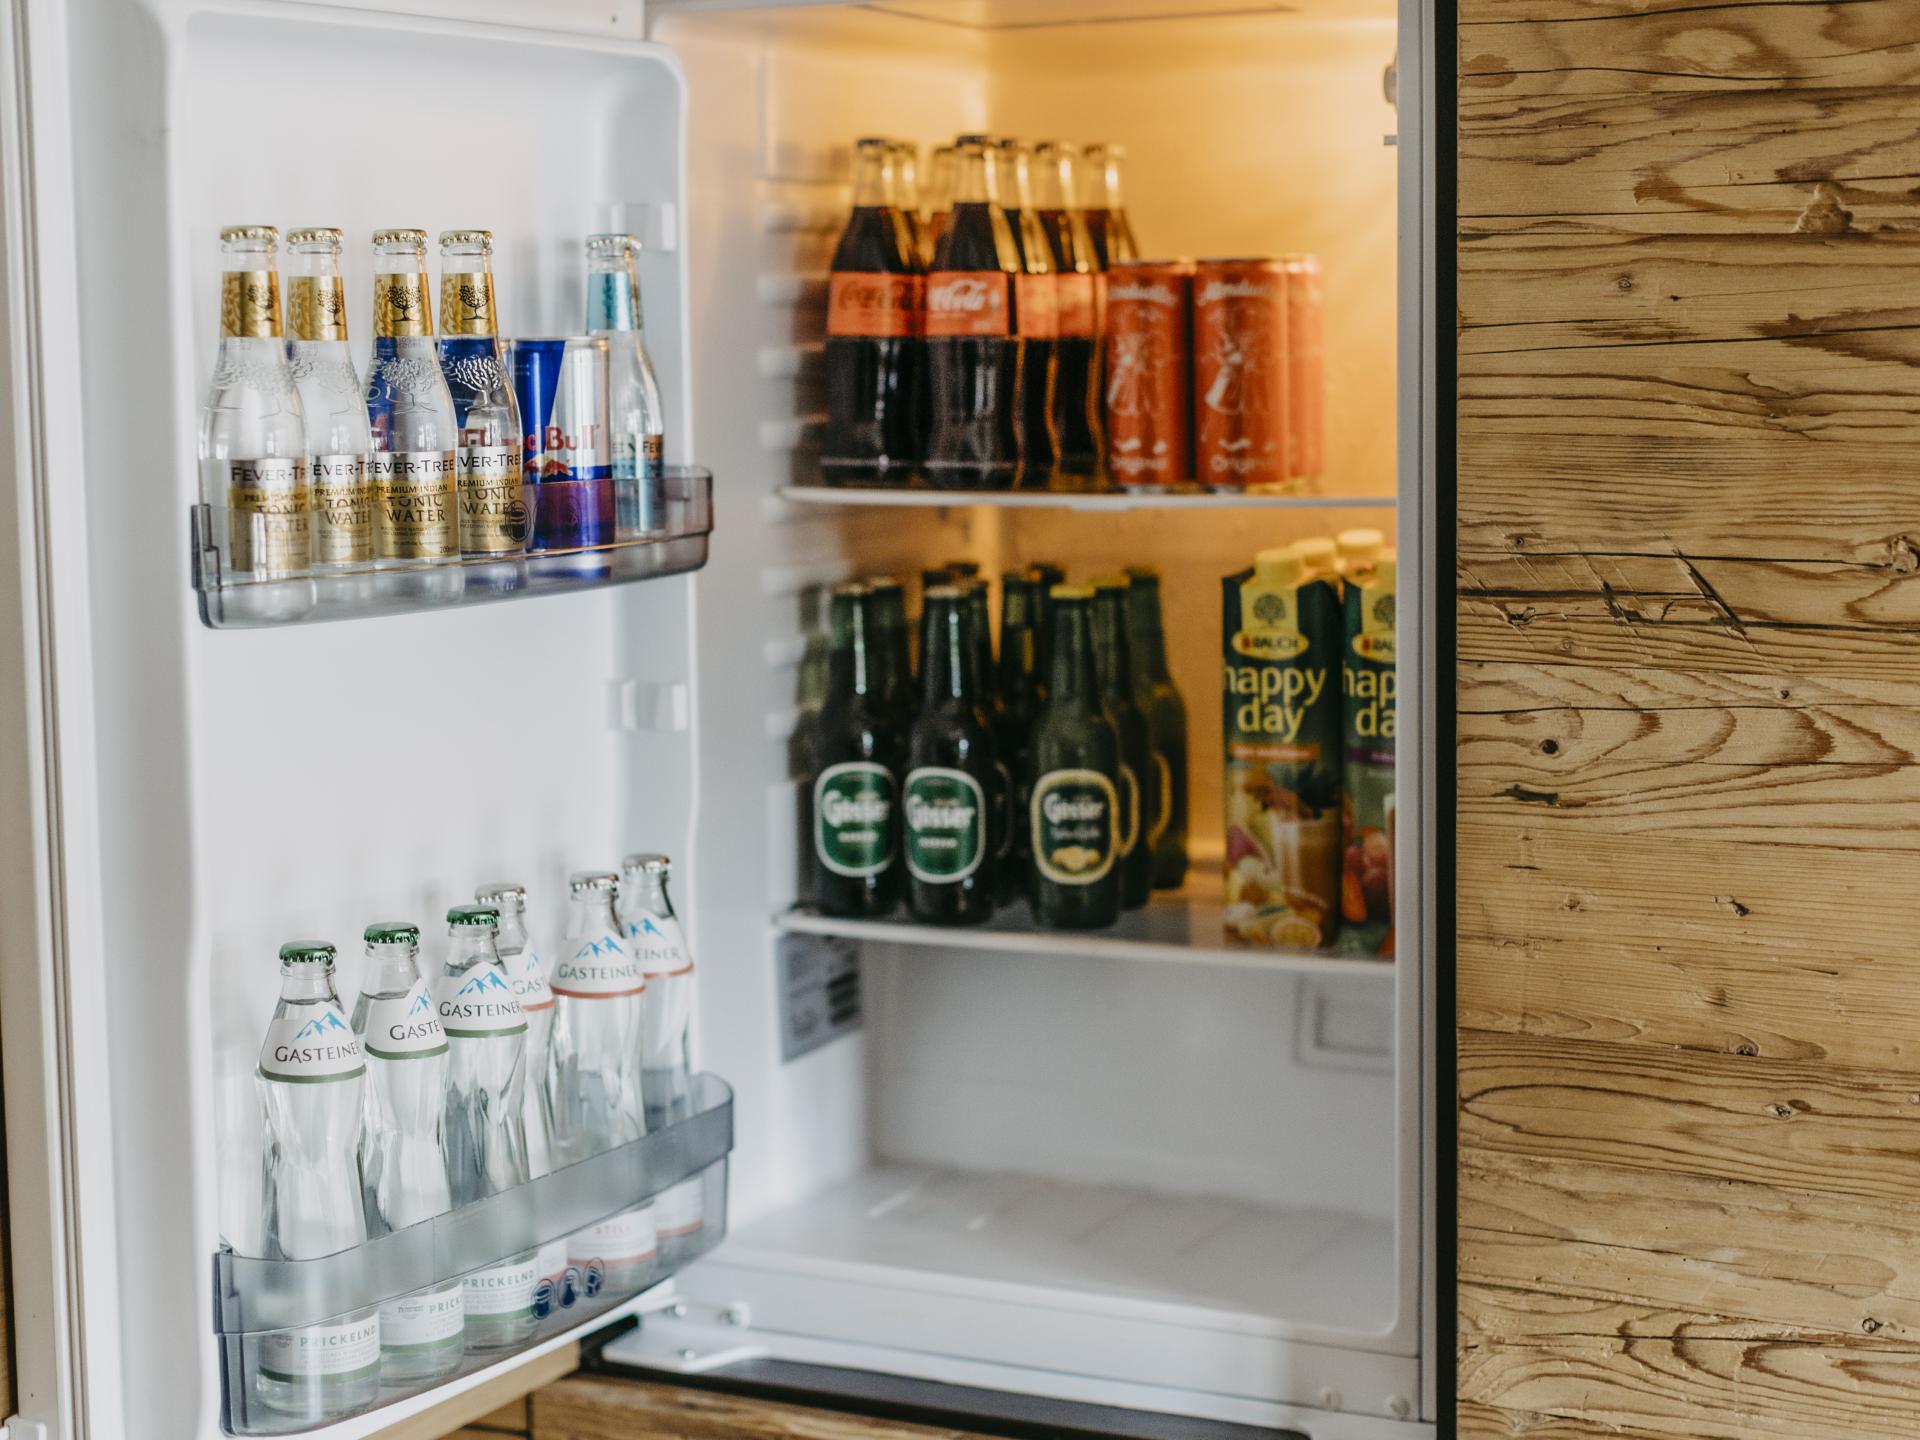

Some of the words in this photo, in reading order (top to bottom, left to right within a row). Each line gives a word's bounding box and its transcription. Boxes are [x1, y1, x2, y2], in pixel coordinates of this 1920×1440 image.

[372, 459, 454, 473] EVER-TREE
[377, 486, 417, 494] PREMIUM
[458, 479, 493, 487] REMIUM
[463, 486, 515, 500] TONIC
[387, 495, 442, 507] TONIC
[387, 510, 445, 522] WATER
[1237, 696, 1304, 743] day
[439, 1001, 522, 1019] GASTEINER
[300, 1325, 375, 1347] PICKELND
